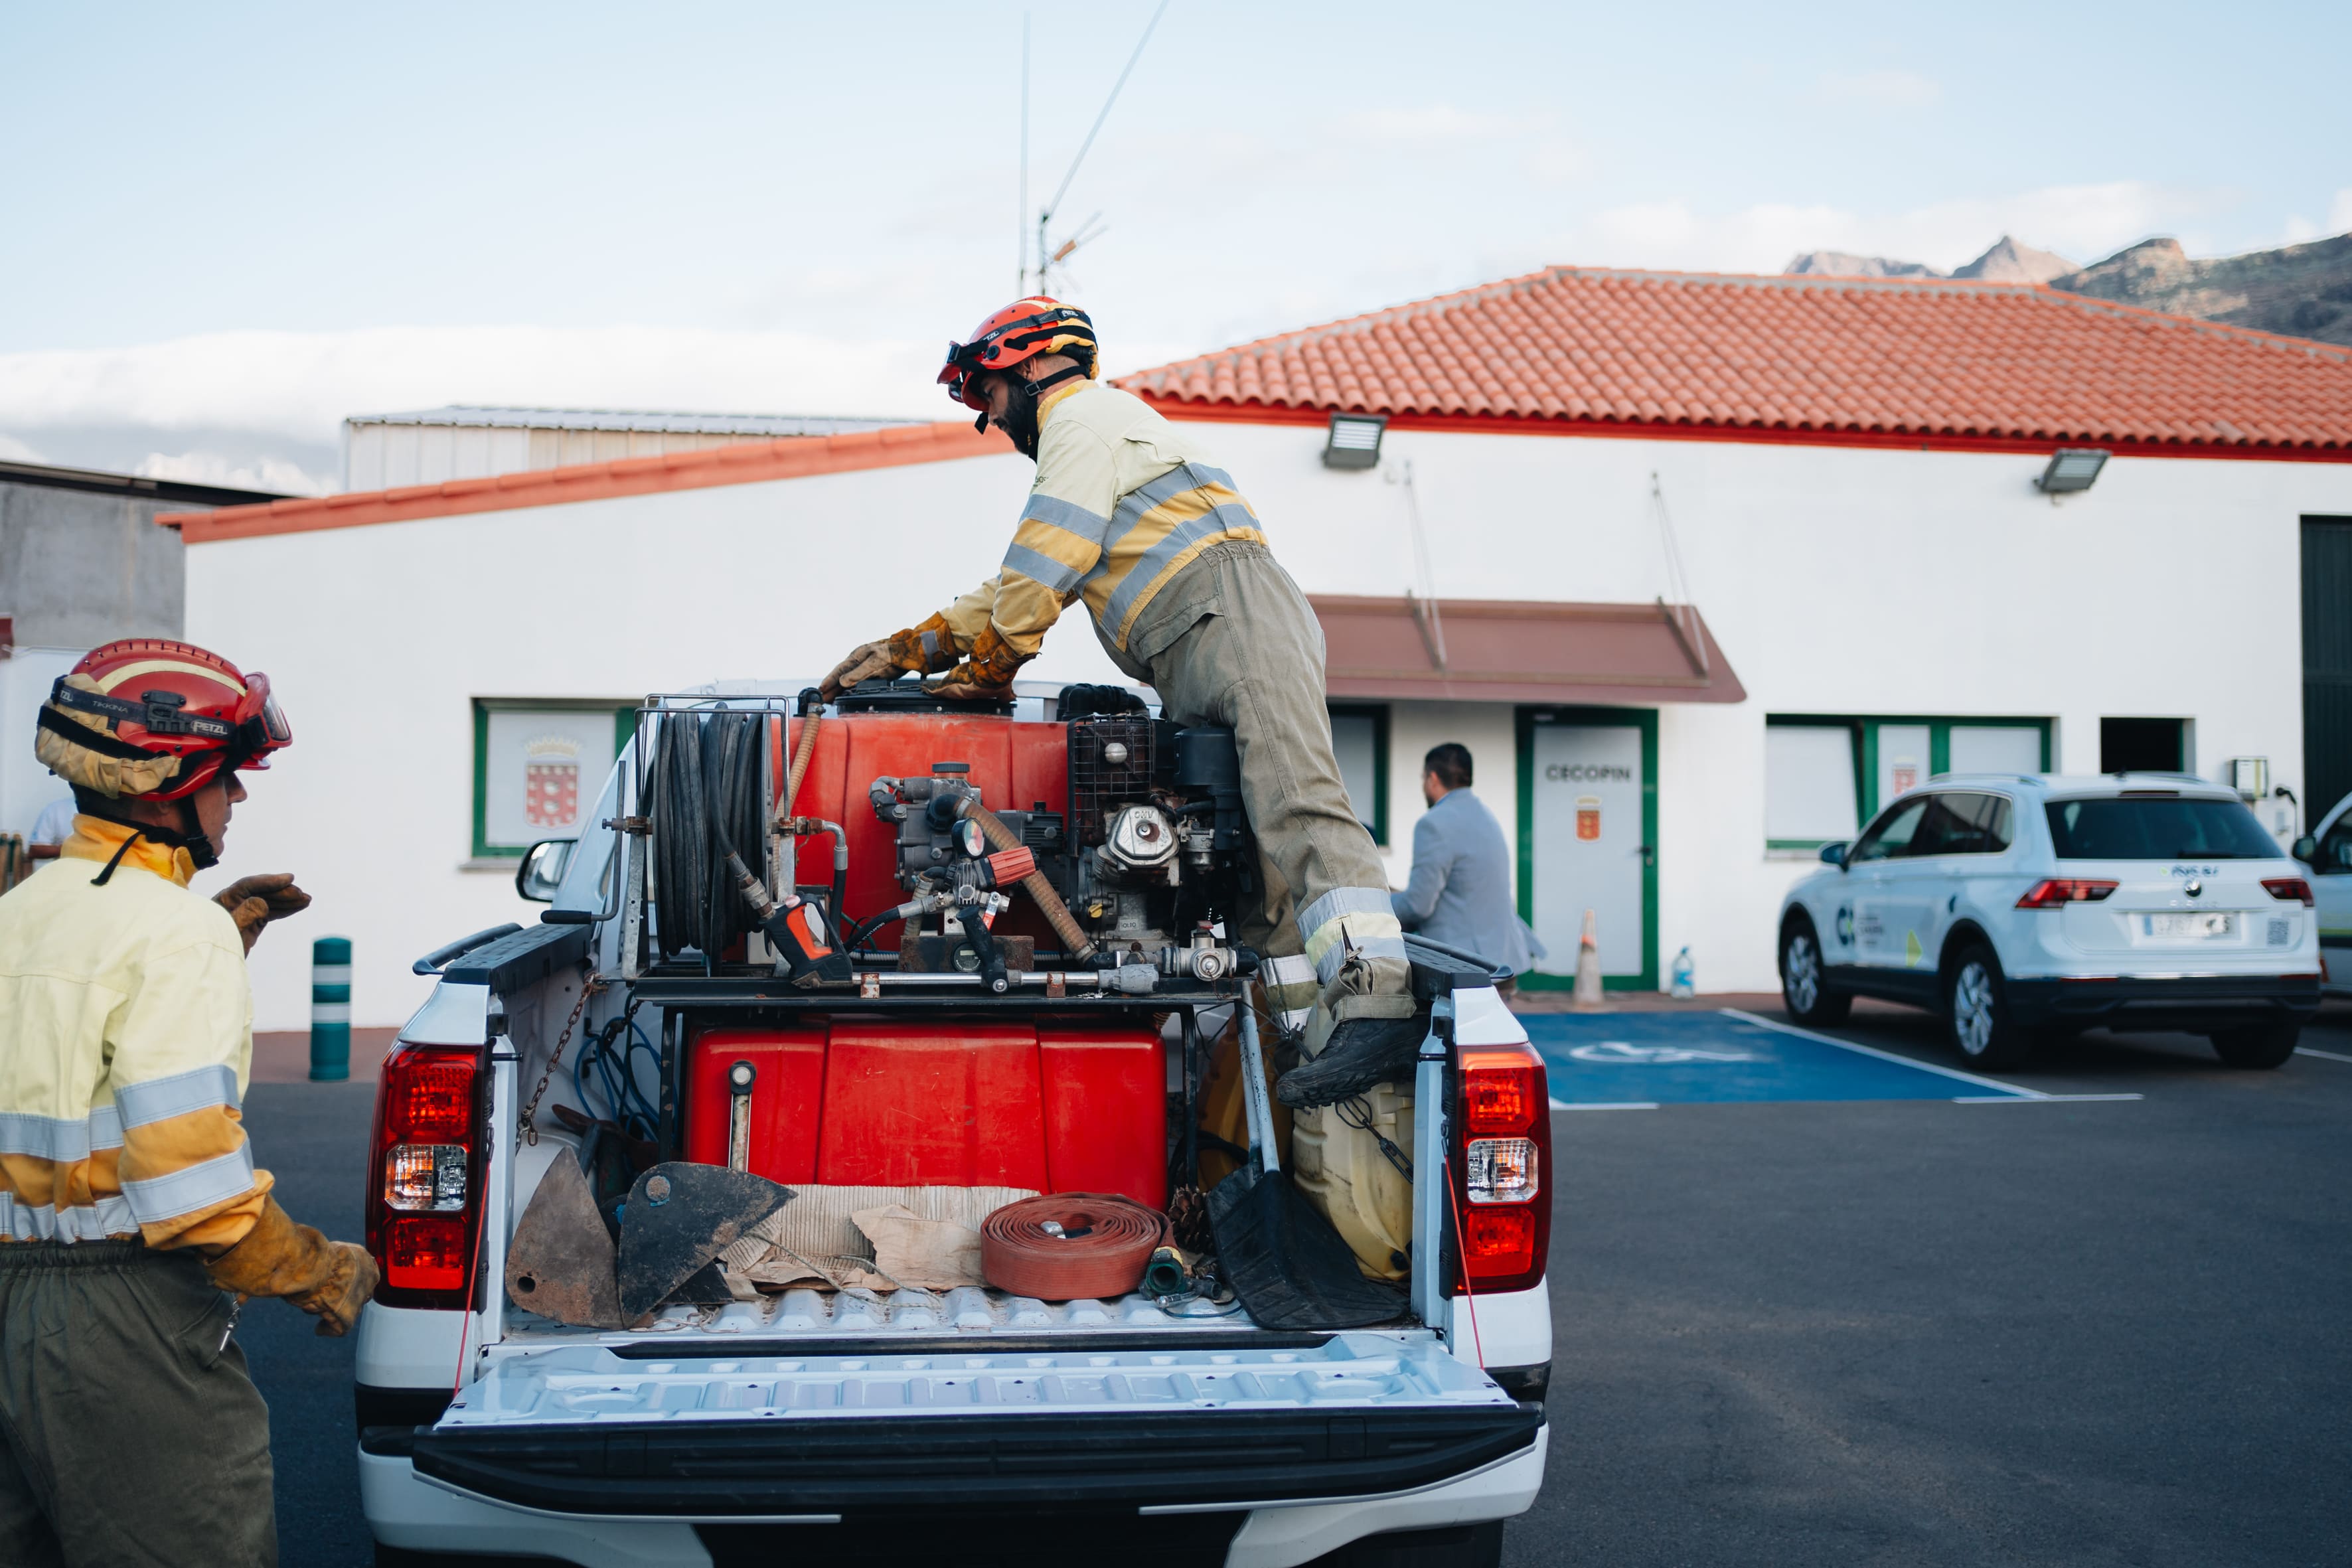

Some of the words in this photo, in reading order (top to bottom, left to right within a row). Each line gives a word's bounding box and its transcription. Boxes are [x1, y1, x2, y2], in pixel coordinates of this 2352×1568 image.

[983, 331, 1000, 341] TZL
[60, 690, 73, 702] TZL
[93, 700, 128, 713] TIKKINA
[193, 721, 228, 735] PETZL
[1545, 765, 1630, 781] CECOPIN
